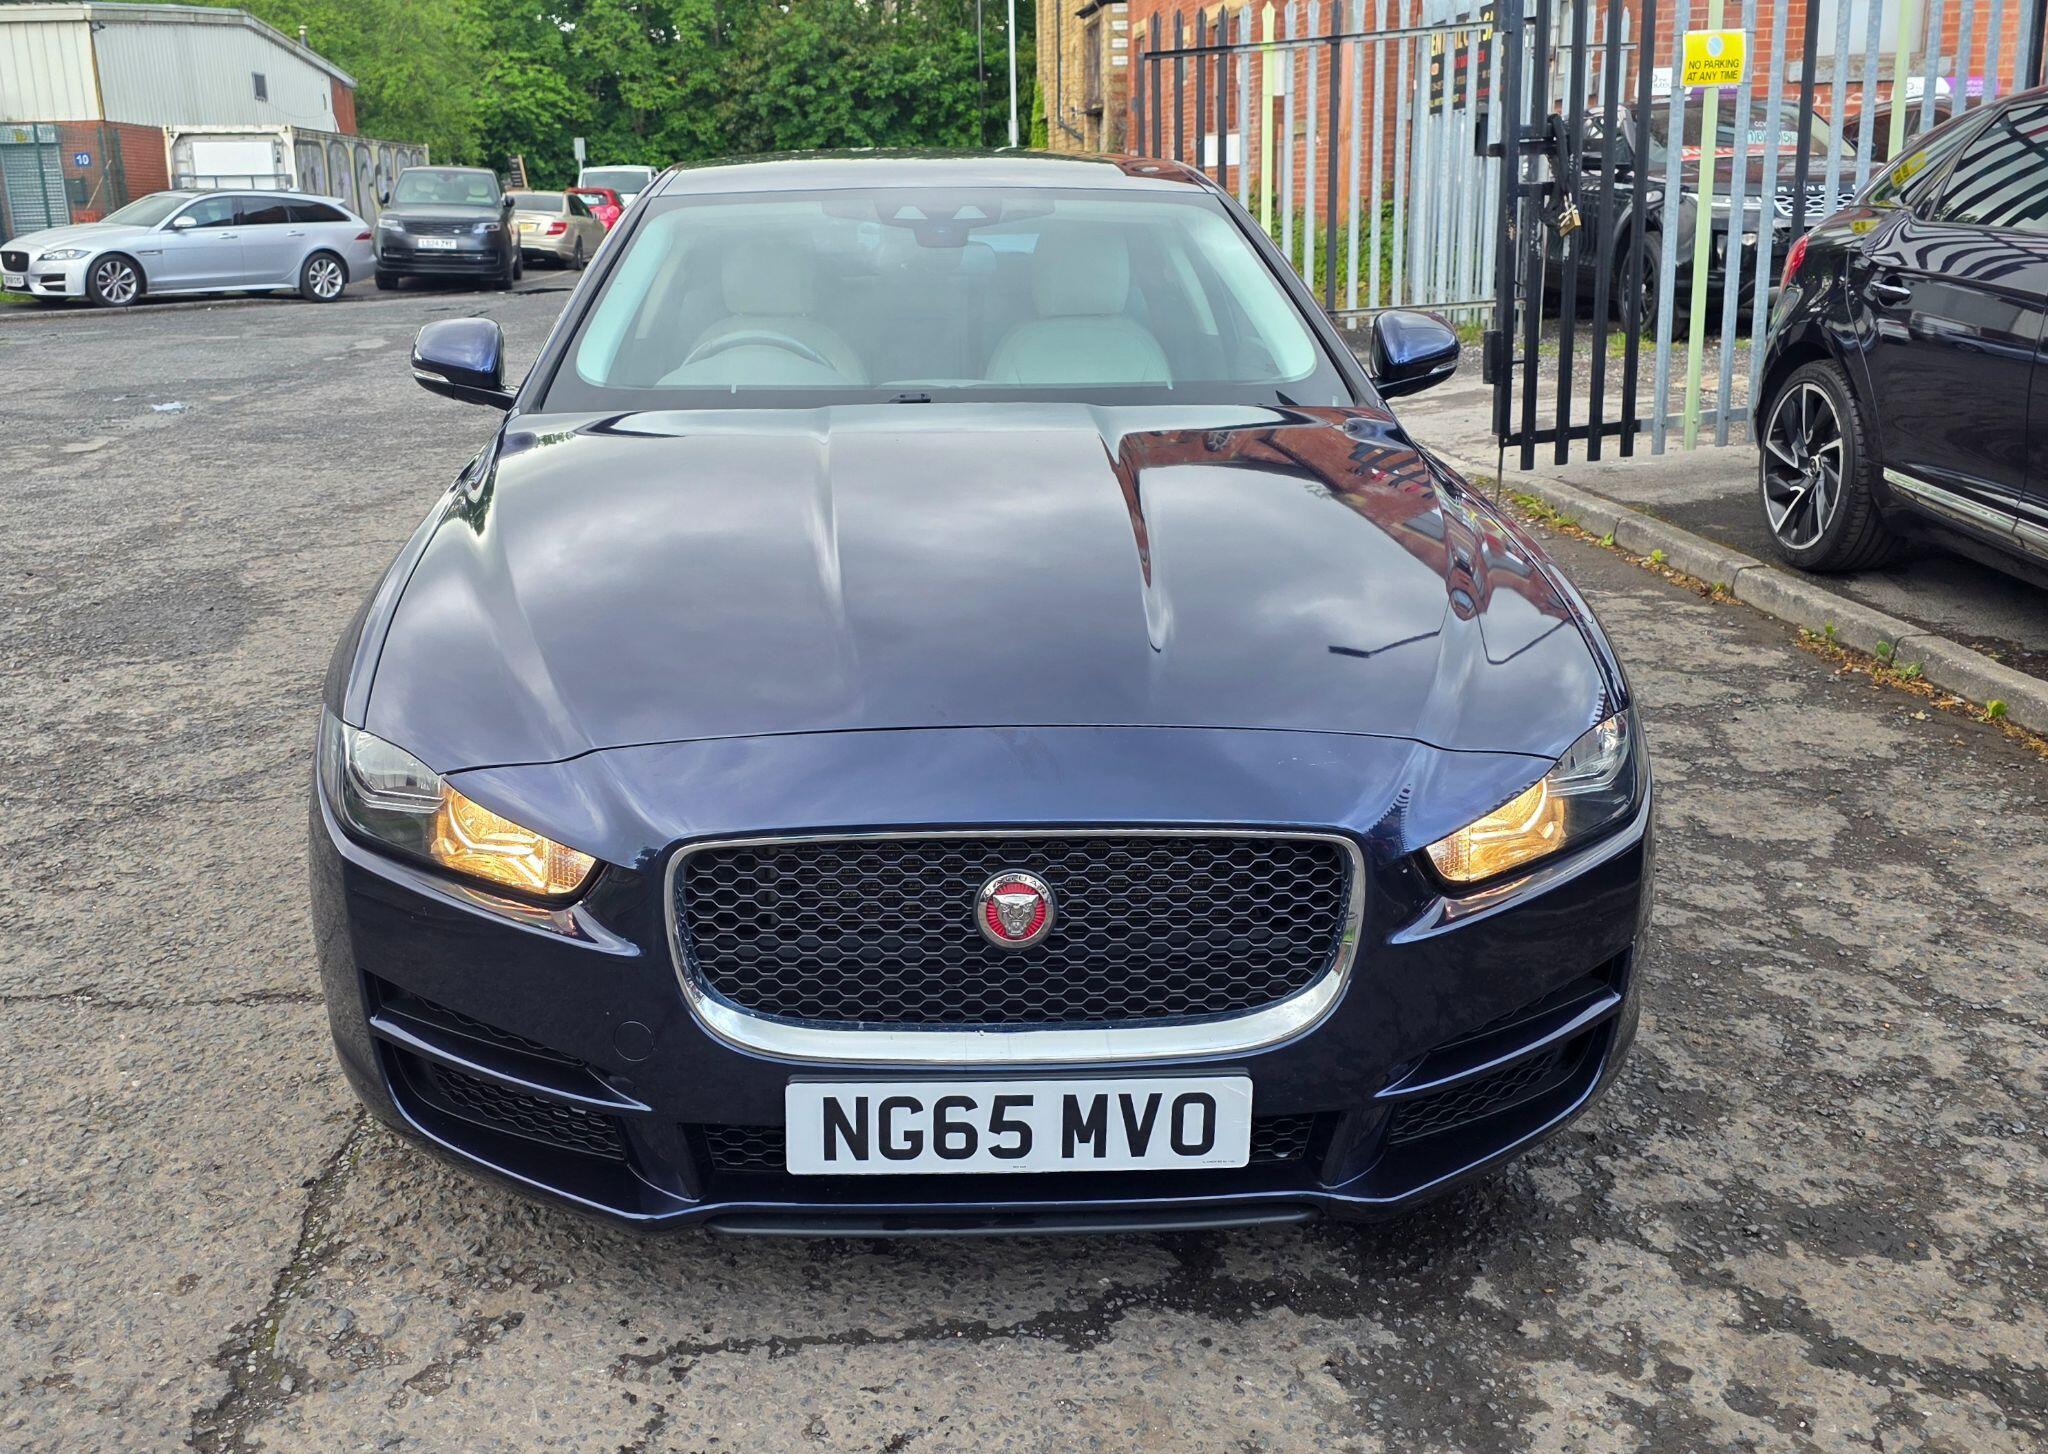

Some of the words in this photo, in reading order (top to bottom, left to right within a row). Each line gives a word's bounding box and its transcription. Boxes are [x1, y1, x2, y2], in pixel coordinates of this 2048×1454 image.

[1689, 61, 1701, 70] NO
[1704, 59, 1739, 69] PARKING
[1687, 71, 1697, 81] AT
[1699, 71, 1717, 81] ANY
[1720, 70, 1739, 80] TIME
[76, 154, 90, 165] 10
[983, 874, 1049, 900] JAGUAR
[823, 1095, 1034, 1161] NG65
[1061, 1092, 1216, 1158] MVO
